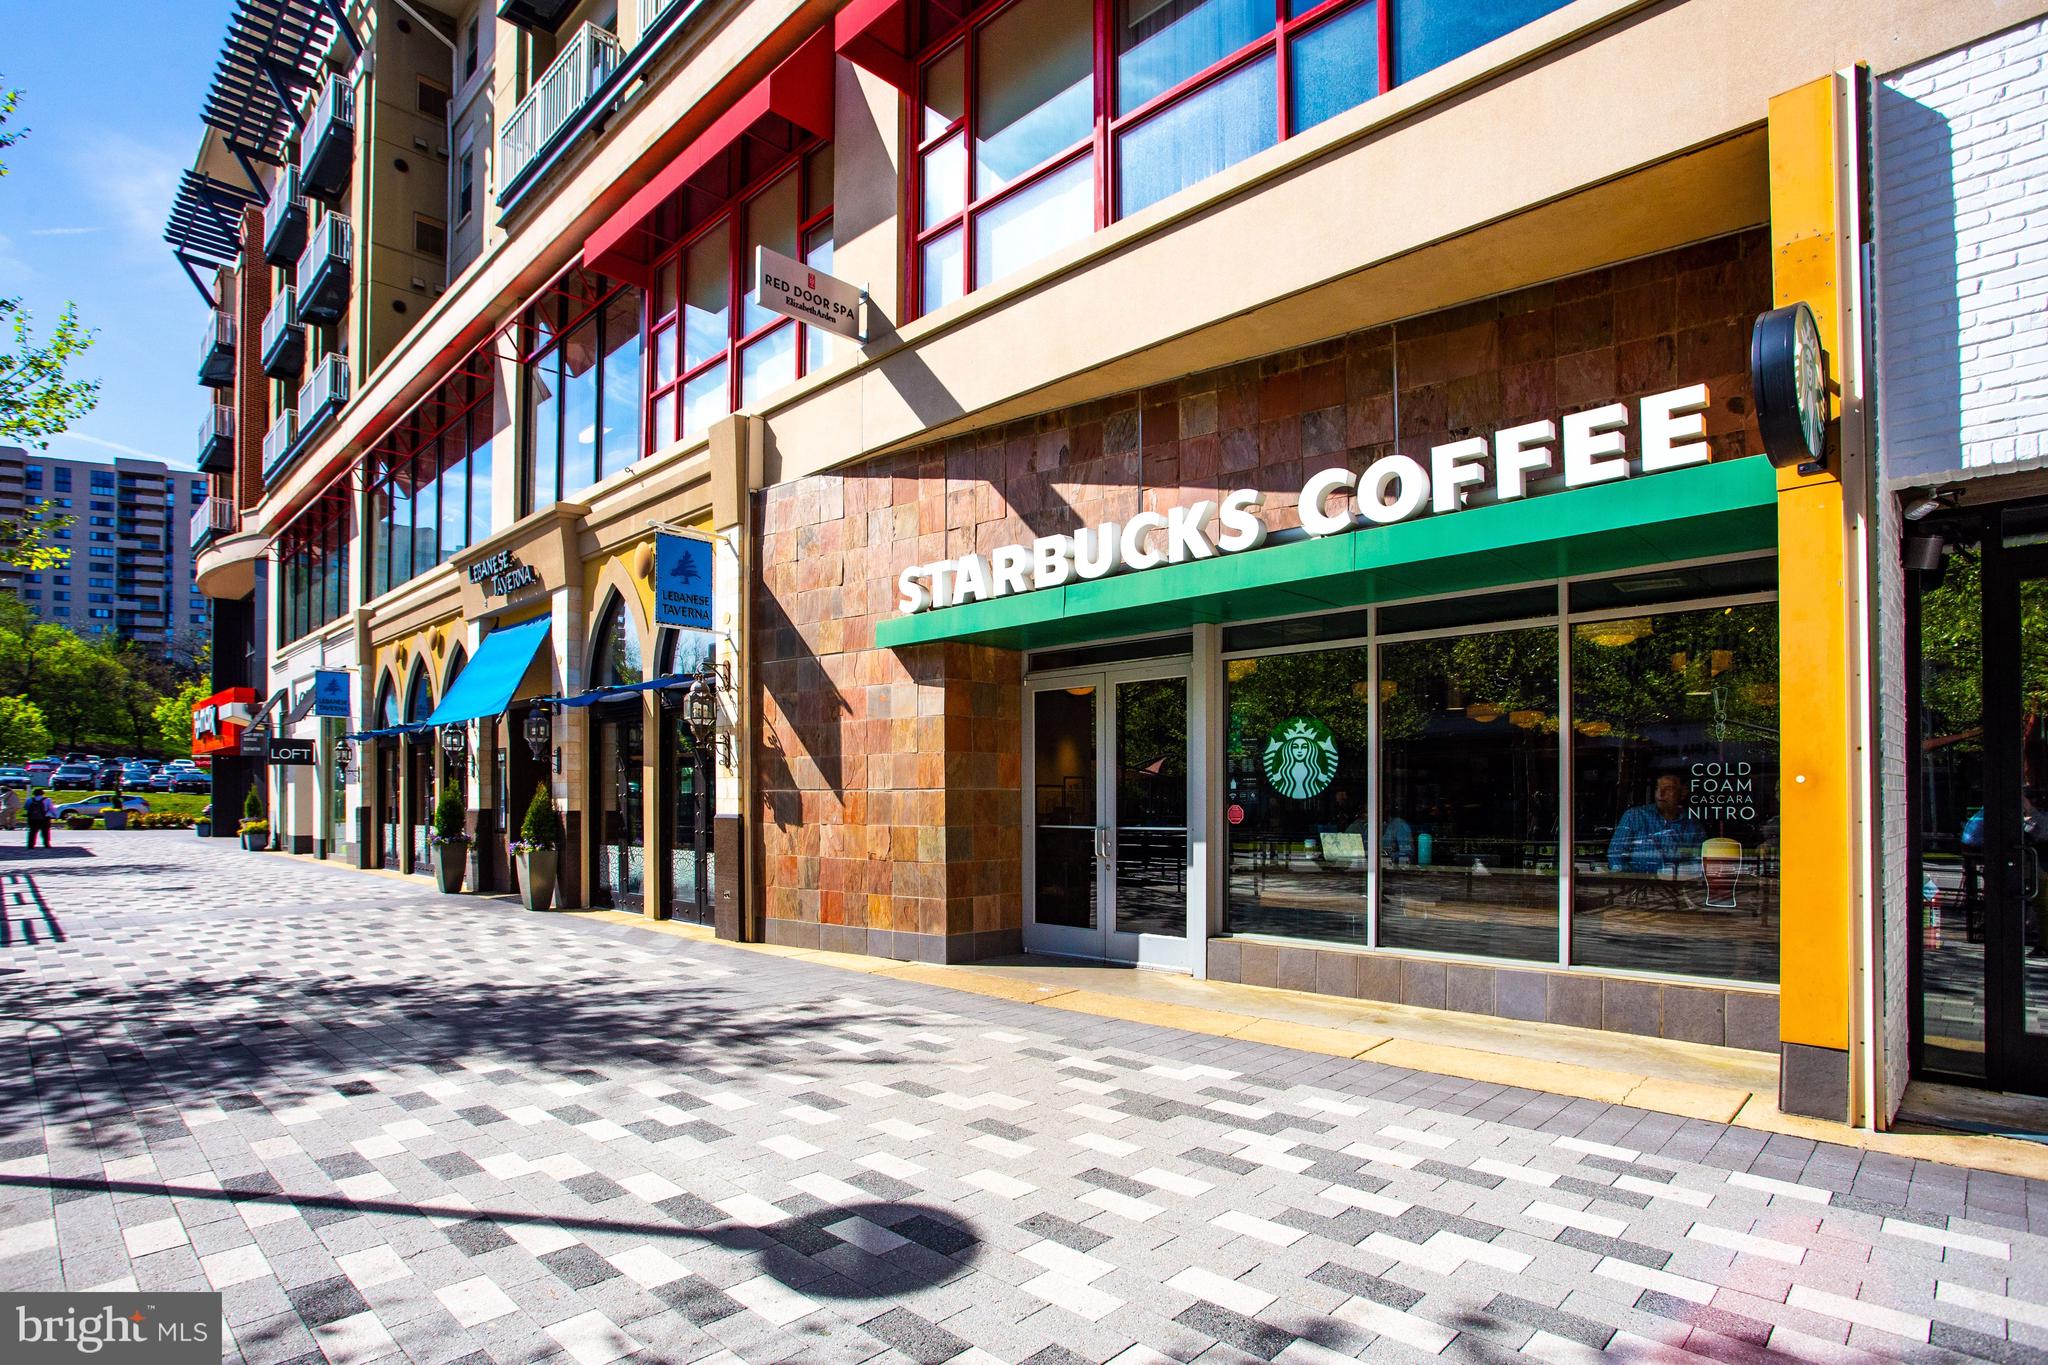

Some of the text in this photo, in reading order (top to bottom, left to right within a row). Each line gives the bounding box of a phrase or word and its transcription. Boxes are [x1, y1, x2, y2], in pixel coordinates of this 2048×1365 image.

[765, 274, 855, 320] RED DOOR SPA
[898, 383, 1712, 615] STARBUCKS COFFEE
[491, 565, 534, 596] TAVERNA
[662, 590, 710, 606] LEBANESE
[662, 603, 710, 620] TAVERNA
[271, 748, 311, 760] LOFT
[1691, 762, 1751, 776] COLD
[1690, 779, 1752, 792] FOAM
[1690, 794, 1753, 804] CASCARA
[1688, 806, 1755, 820] NITRO
